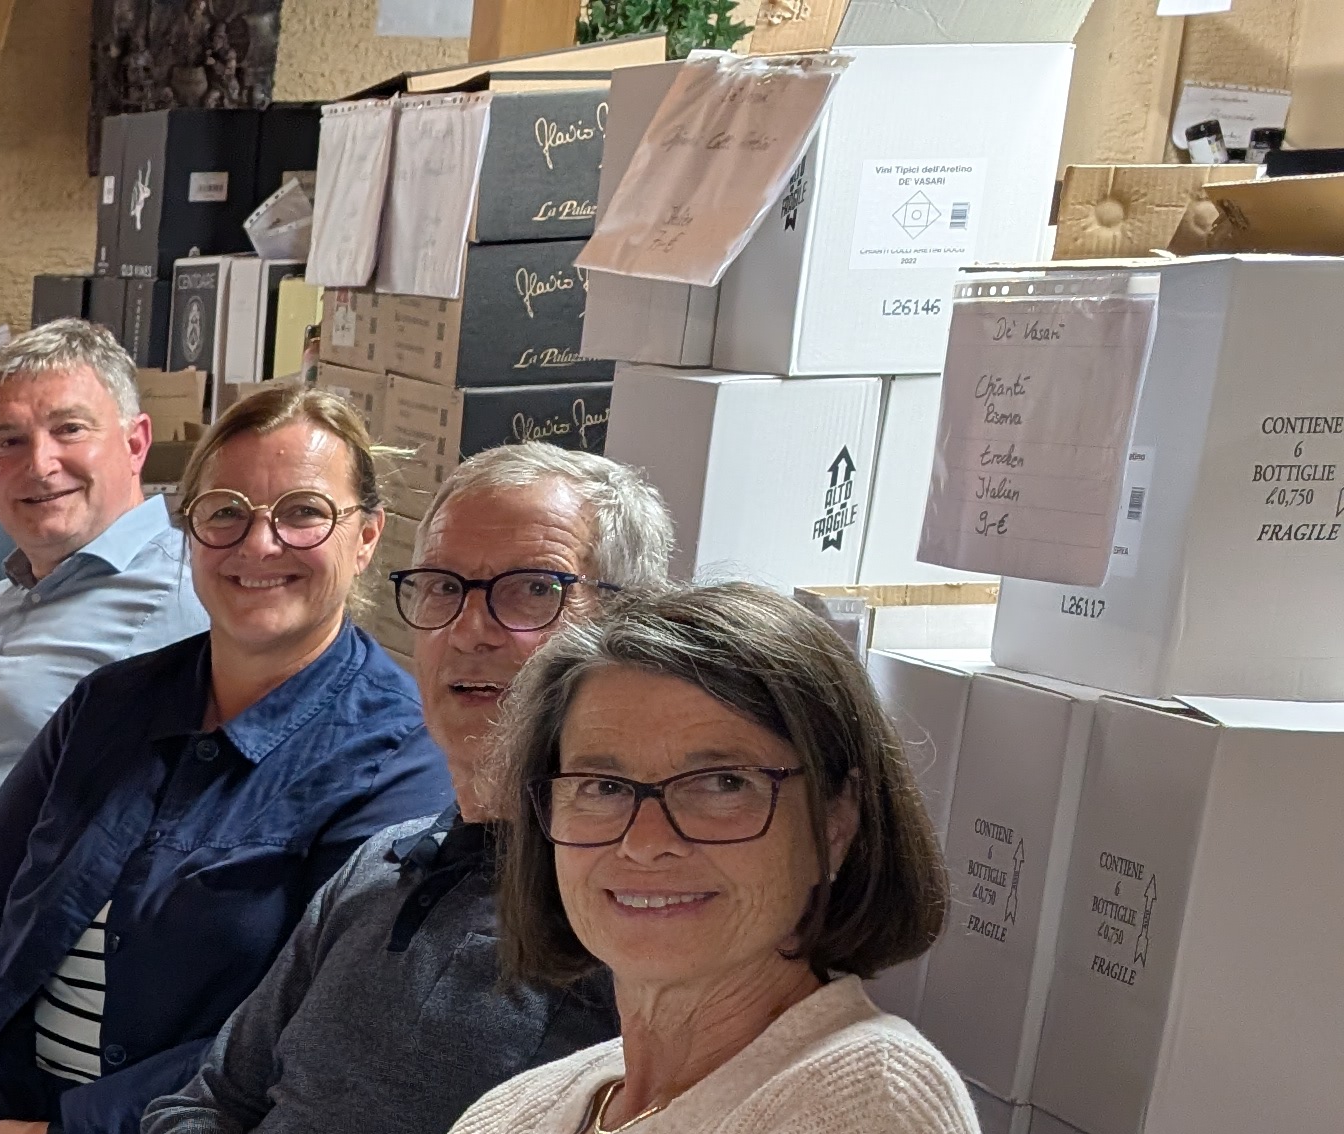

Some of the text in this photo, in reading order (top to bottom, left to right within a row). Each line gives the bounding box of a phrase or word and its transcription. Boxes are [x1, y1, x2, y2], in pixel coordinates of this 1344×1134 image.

[875, 165, 893, 174] Vini
[895, 165, 920, 175] Tipici
[914, 177, 946, 186] VASARI
[532, 201, 556, 221] La
[882, 299, 942, 316] L26146
[513, 349, 537, 369] La
[975, 374, 1031, 406] Chianti
[1261, 416, 1344, 435] CONTIENE
[980, 444, 1024, 468] trocken
[1293, 440, 1304, 458] 6
[1252, 464, 1336, 483] BOTTIGLIE
[824, 480, 853, 510] ALTO
[975, 477, 1020, 502] Italien
[812, 503, 858, 541] FRAGILE
[1256, 523, 1342, 542] FRAGILE
[1061, 595, 1106, 619] L26117
[974, 818, 1014, 845] CONTIENE
[987, 845, 994, 860] 6
[968, 859, 1008, 888] BOTTIGLIE
[1099, 851, 1145, 881] CONTIENE
[1114, 881, 1122, 897] 6
[1091, 896, 1138, 927] BOTTIGLIE
[967, 914, 1008, 943] FRAGILE
[1091, 955, 1137, 986] FRAGILE
